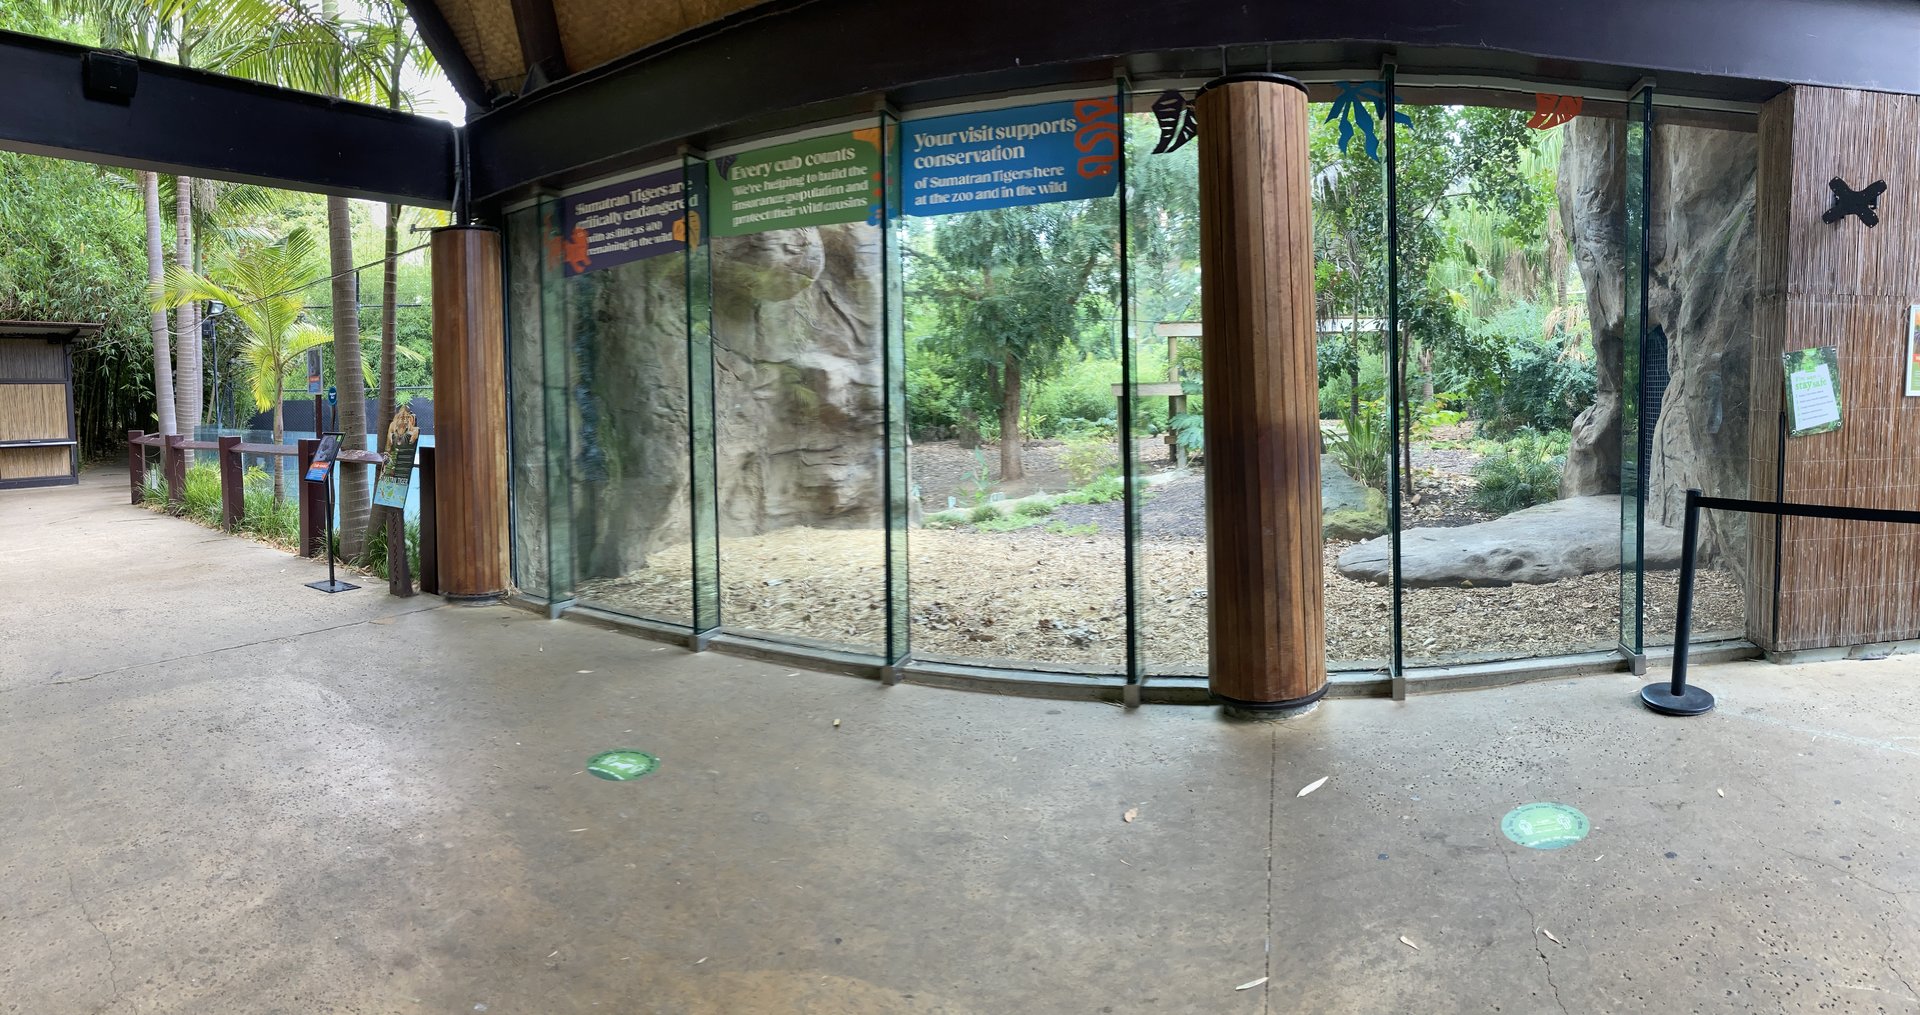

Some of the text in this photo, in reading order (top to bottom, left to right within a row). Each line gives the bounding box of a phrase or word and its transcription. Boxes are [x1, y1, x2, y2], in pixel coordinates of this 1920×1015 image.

[914, 117, 1077, 152] Your visit supports
[731, 147, 856, 181] Every cub counts
[914, 144, 1026, 169] conservation
[763, 174, 805, 190] helping
[806, 173, 818, 183] to
[818, 168, 848, 181] build
[848, 165, 869, 177] the
[914, 166, 1065, 190] of Sumatran Tigers here
[575, 195, 630, 215] Sumatran
[629, 188, 668, 203] Tigers
[732, 180, 869, 211] insurance population and
[799, 202, 825, 215] wild
[822, 197, 868, 212] cousins
[915, 181, 1068, 206] at the zoo and in the wild
